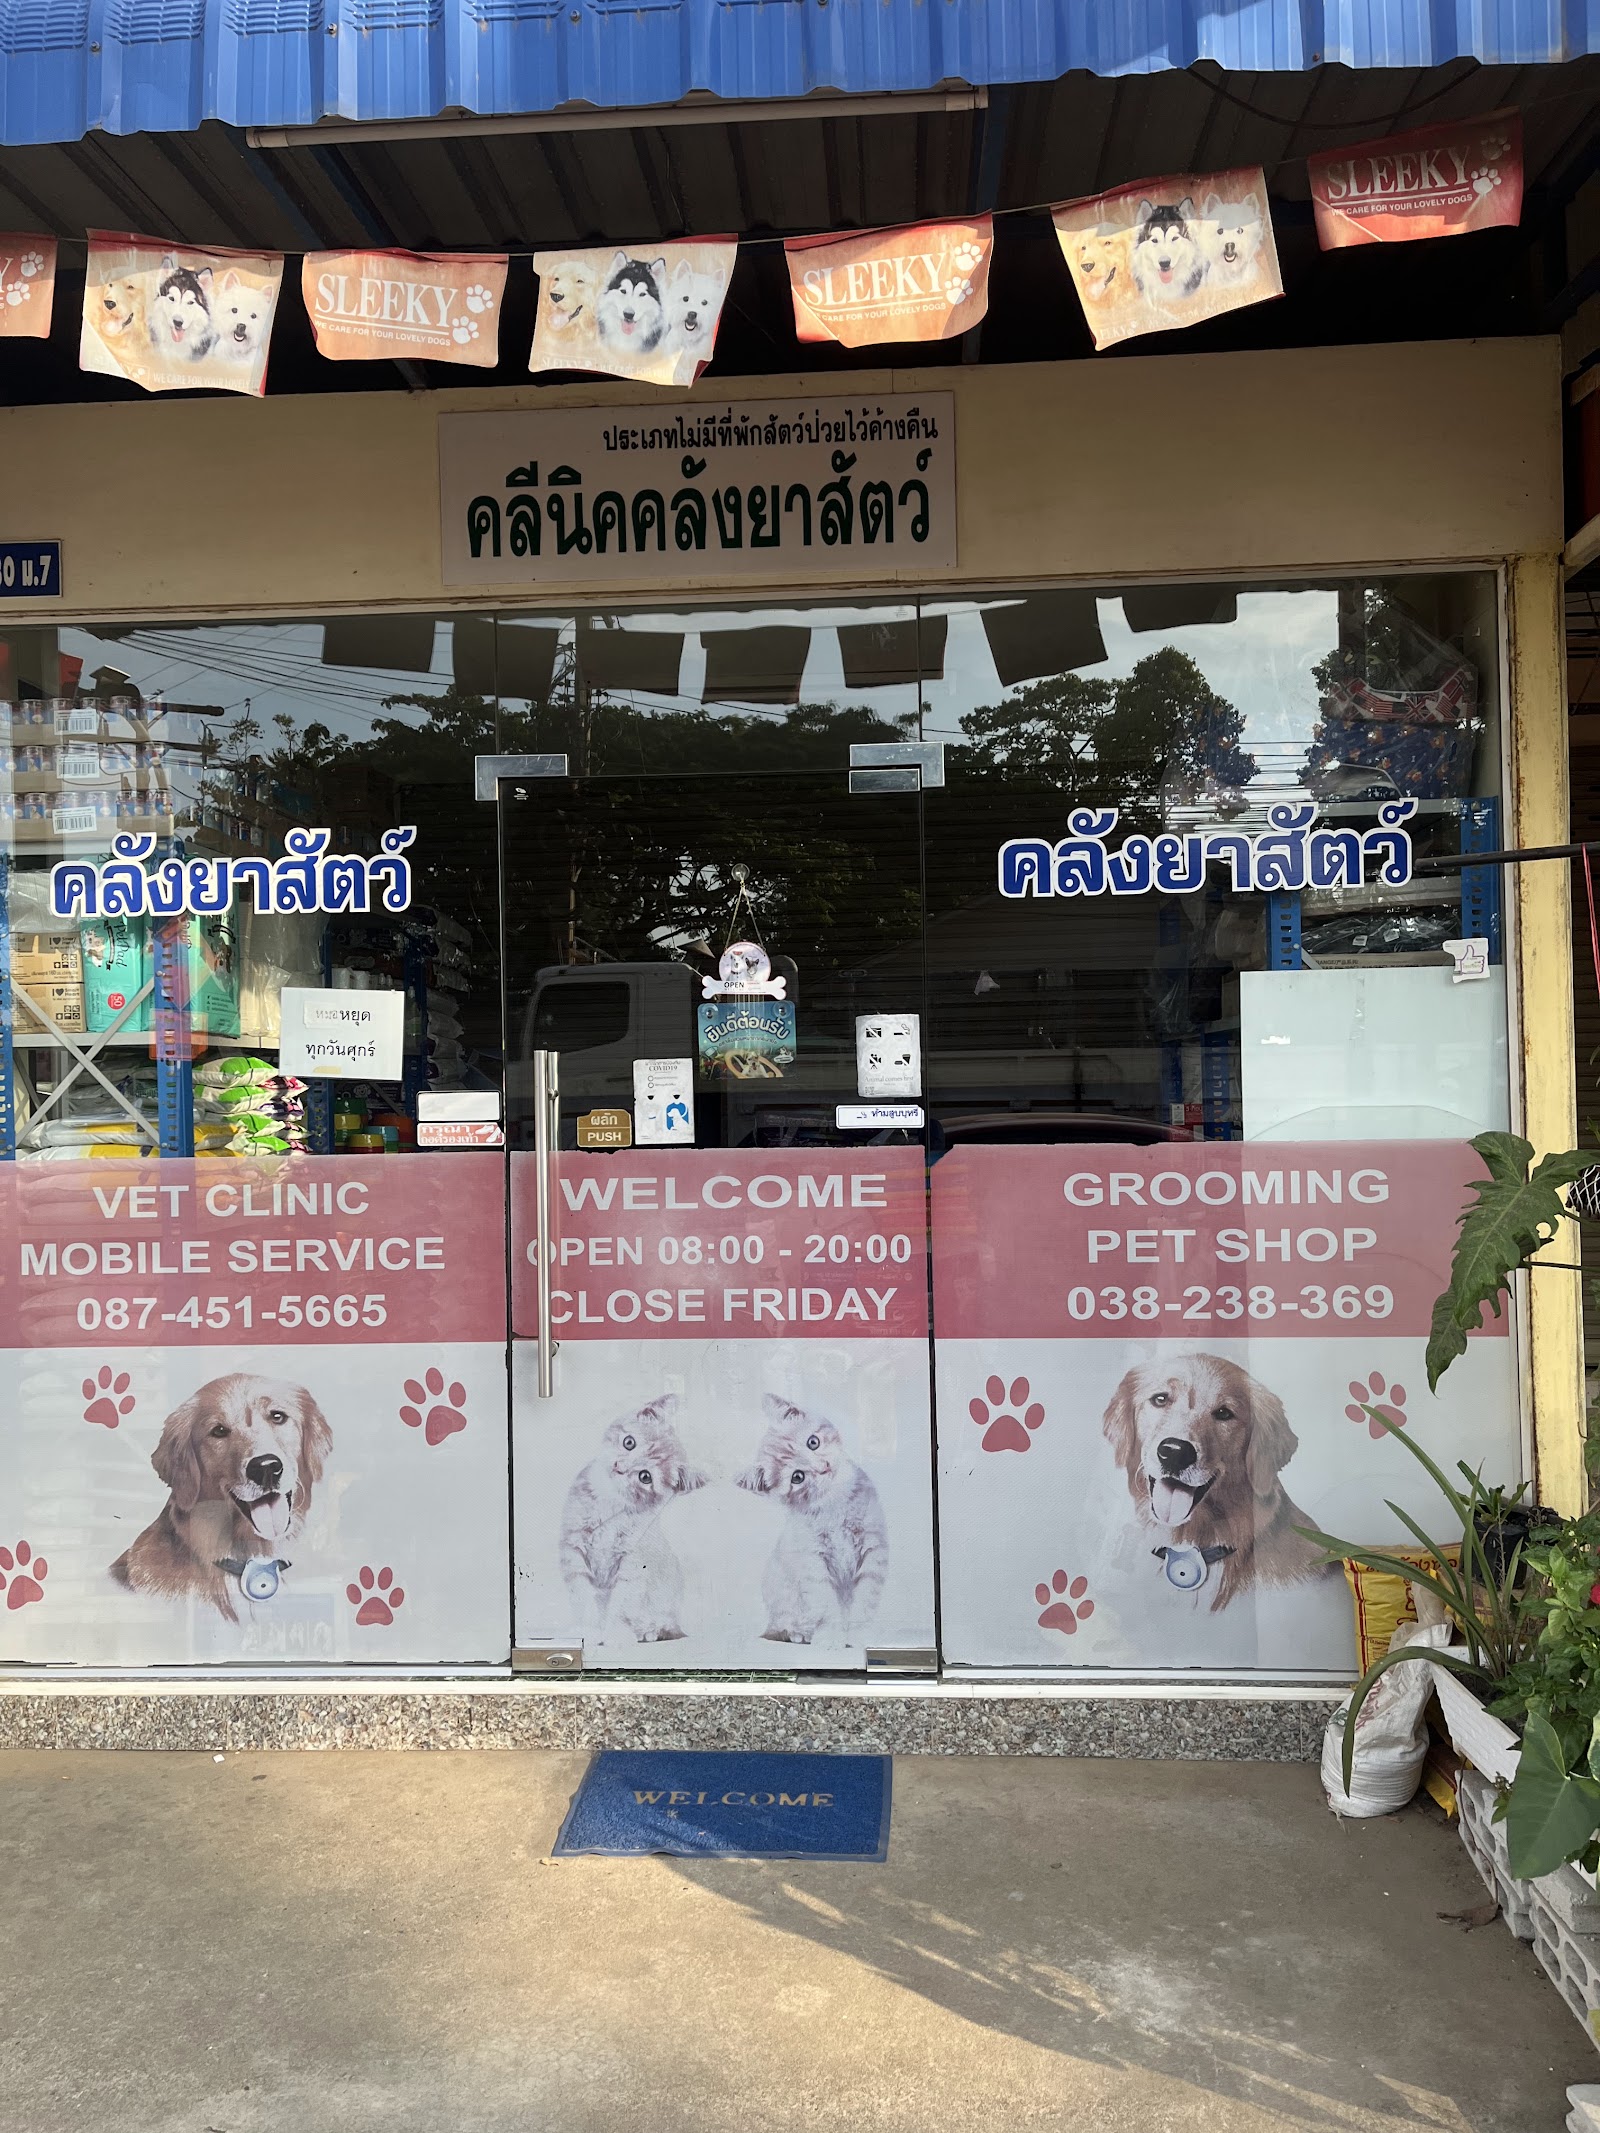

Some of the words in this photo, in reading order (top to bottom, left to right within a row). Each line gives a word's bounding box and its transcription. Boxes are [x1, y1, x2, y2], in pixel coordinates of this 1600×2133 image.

[1327, 145, 1470, 200] SLEEKY
[1346, 205, 1369, 215] CARE
[1371, 203, 1387, 212] FOR
[1389, 202, 1412, 211] YOUR
[1414, 198, 1446, 209] LOVELY
[1447, 193, 1473, 205] DOGS
[803, 251, 946, 306] SLEEKY
[314, 273, 458, 328] SLEEKY
[822, 313, 844, 322] CARE
[846, 311, 863, 321] FOR
[865, 309, 888, 319] YOUR
[889, 306, 922, 316] LOVELY
[922, 302, 946, 312] DOGS
[314, 320, 327, 330] WE
[328, 323, 352, 334] CARE
[353, 327, 369, 337] FOR
[371, 328, 394, 339] YOUR
[395, 333, 427, 343] LOVELY
[427, 336, 451, 347] DOGS
[153, 373, 165, 384] WE
[603, 406, 939, 451] ประเภทไม่มีที่พักสัตว์ป่วยไว้ค้างคืน
[467, 447, 933, 558] คลีนิคคลังยาสัตว์
[21, 555, 52, 587] ม.7
[997, 797, 1418, 899] คลังยาสัตว์
[50, 825, 417, 918] คลังยาสัตว์
[724, 981, 745, 989] OPEN
[704, 1011, 790, 1043] ยินดีต้อนรับ
[305, 1039, 376, 1062] ทุกวันศุกร์
[421, 1125, 470, 1137] กรุณา
[587, 1131, 622, 1142] PUSH
[590, 1112, 618, 1126] ผลัก
[420, 1132, 479, 1144] ถอดรองเท้า
[92, 1185, 189, 1219] VET
[204, 1181, 370, 1218] CLINIC
[559, 1174, 888, 1211] WELCOME
[1063, 1169, 1390, 1207] GROOMING
[20, 1240, 211, 1276] MOBILE
[227, 1236, 446, 1273] SERVICE
[526, 1236, 643, 1267] OPEN
[658, 1235, 764, 1266] 08:00
[804, 1234, 912, 1264] 20:00
[1087, 1229, 1196, 1264] PET
[1215, 1227, 1378, 1263] SHOP
[76, 1293, 388, 1331] 087-451-5665
[551, 1289, 706, 1324] CLOSE
[723, 1287, 898, 1322] FRIDAY
[1066, 1284, 1394, 1320] 038-238-369
[632, 1790, 836, 1808] WELCOME
